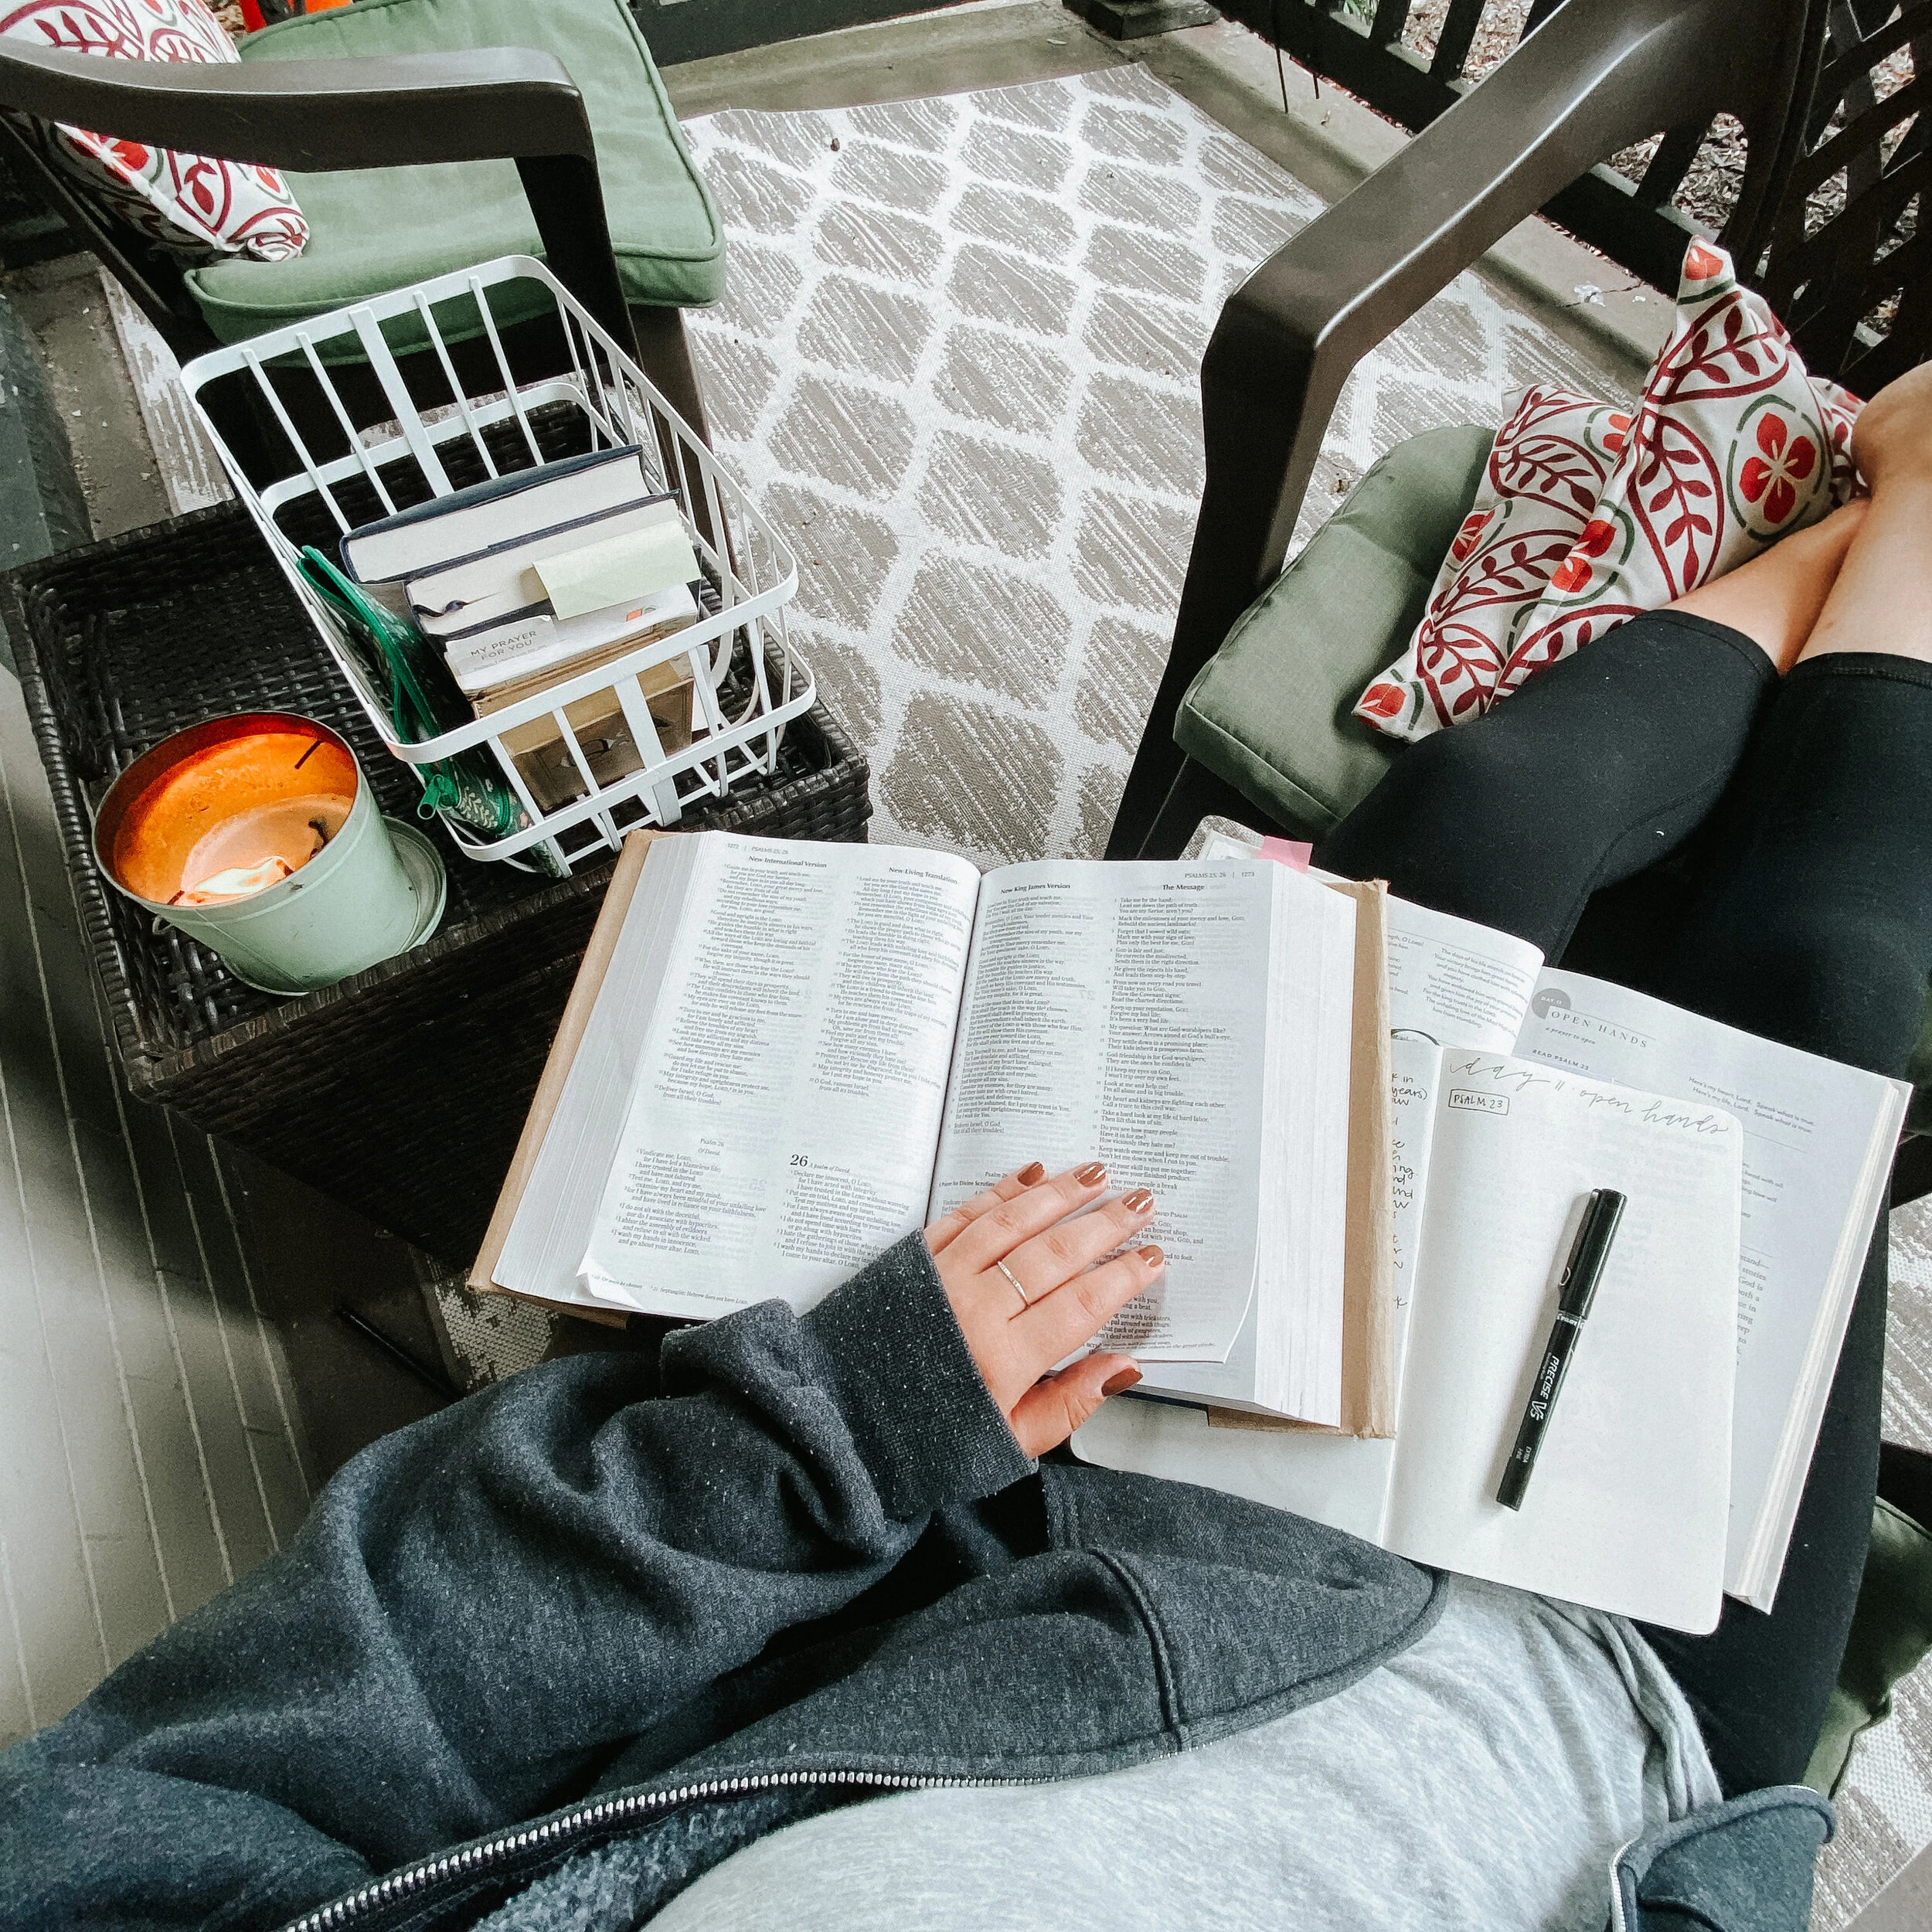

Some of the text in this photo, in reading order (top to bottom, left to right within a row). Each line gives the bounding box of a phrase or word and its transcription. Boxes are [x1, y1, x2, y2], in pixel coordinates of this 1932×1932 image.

[470, 631, 537, 656] MY PRAYER
[481, 649, 505, 660] FOR
[509, 640, 532, 651] YOU
[764, 858, 804, 866] International
[905, 869, 924, 878] Living
[924, 871, 958, 885] Translation
[1541, 995, 1555, 1004] DAY
[1550, 1027, 1572, 1038] prayer
[1581, 1036, 1596, 1046] open
[1551, 1011, 1648, 1048] OPEN HANDS
[1532, 1049, 1553, 1059] READ
[1554, 1055, 1579, 1067] PSALM
[1450, 1057, 1550, 1092] day
[1579, 1090, 1631, 1114] open
[1641, 1100, 1729, 1133] hands
[1453, 1094, 1504, 1110] PSALM 23
[1688, 1076, 1707, 1088] Here's
[1707, 1084, 1717, 1093] my
[1757, 1101, 1776, 1113] Speak
[1777, 1110, 1794, 1119] what
[1692, 1087, 1711, 1098] Here's
[1711, 1094, 1721, 1103] my
[1753, 1108, 1774, 1120] Speak
[1774, 1117, 1791, 1127] what
[789, 1153, 809, 1168] 26
[638, 1240, 654, 1249] about
[1742, 1267, 1767, 1281] stories
[1738, 1277, 1764, 1292] God is
[1748, 1304, 1757, 1313] in
[1540, 1355, 1560, 1400] PRECISE
[1529, 1399, 1547, 1421] V5
[1522, 1446, 1532, 1464] EXTRA
